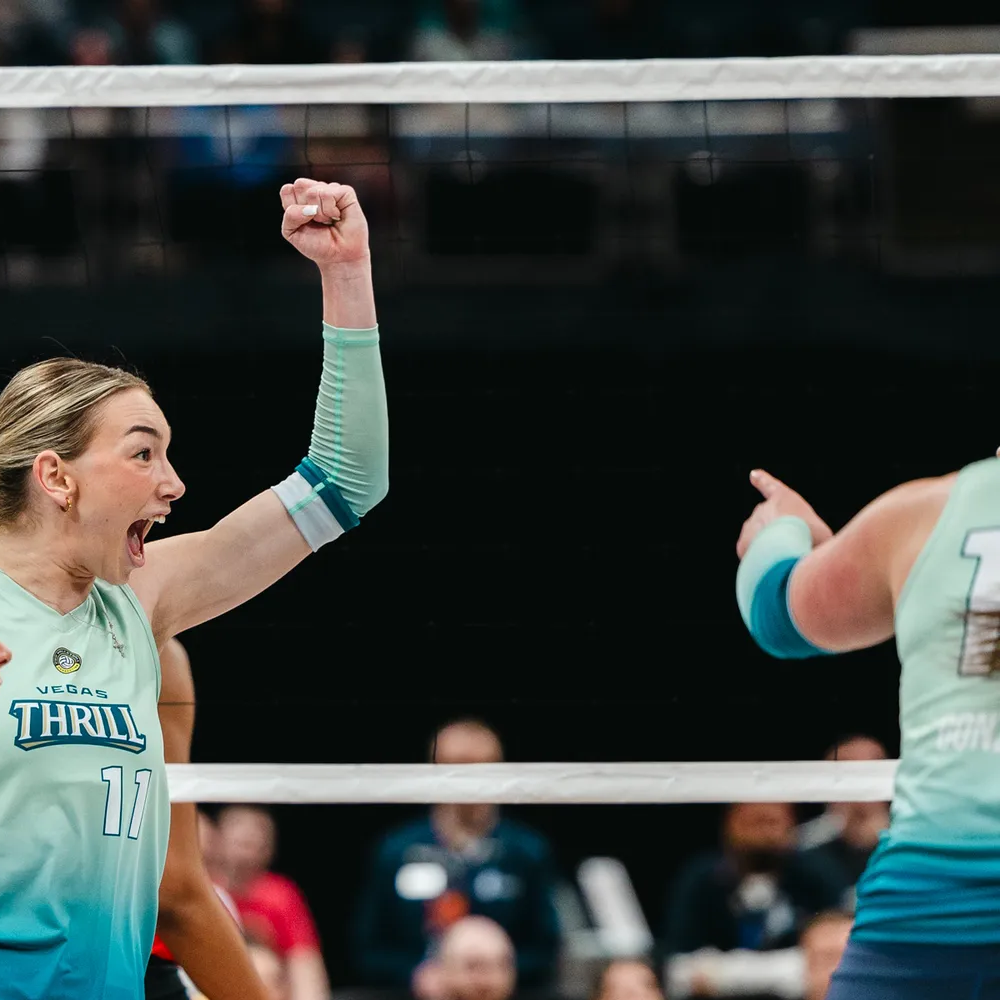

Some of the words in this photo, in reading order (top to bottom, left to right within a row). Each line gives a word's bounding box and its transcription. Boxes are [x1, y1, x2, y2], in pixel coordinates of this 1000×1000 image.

[36, 684, 109, 699] VEGAS
[11, 701, 146, 747] THRILL
[101, 766, 152, 840] 11
